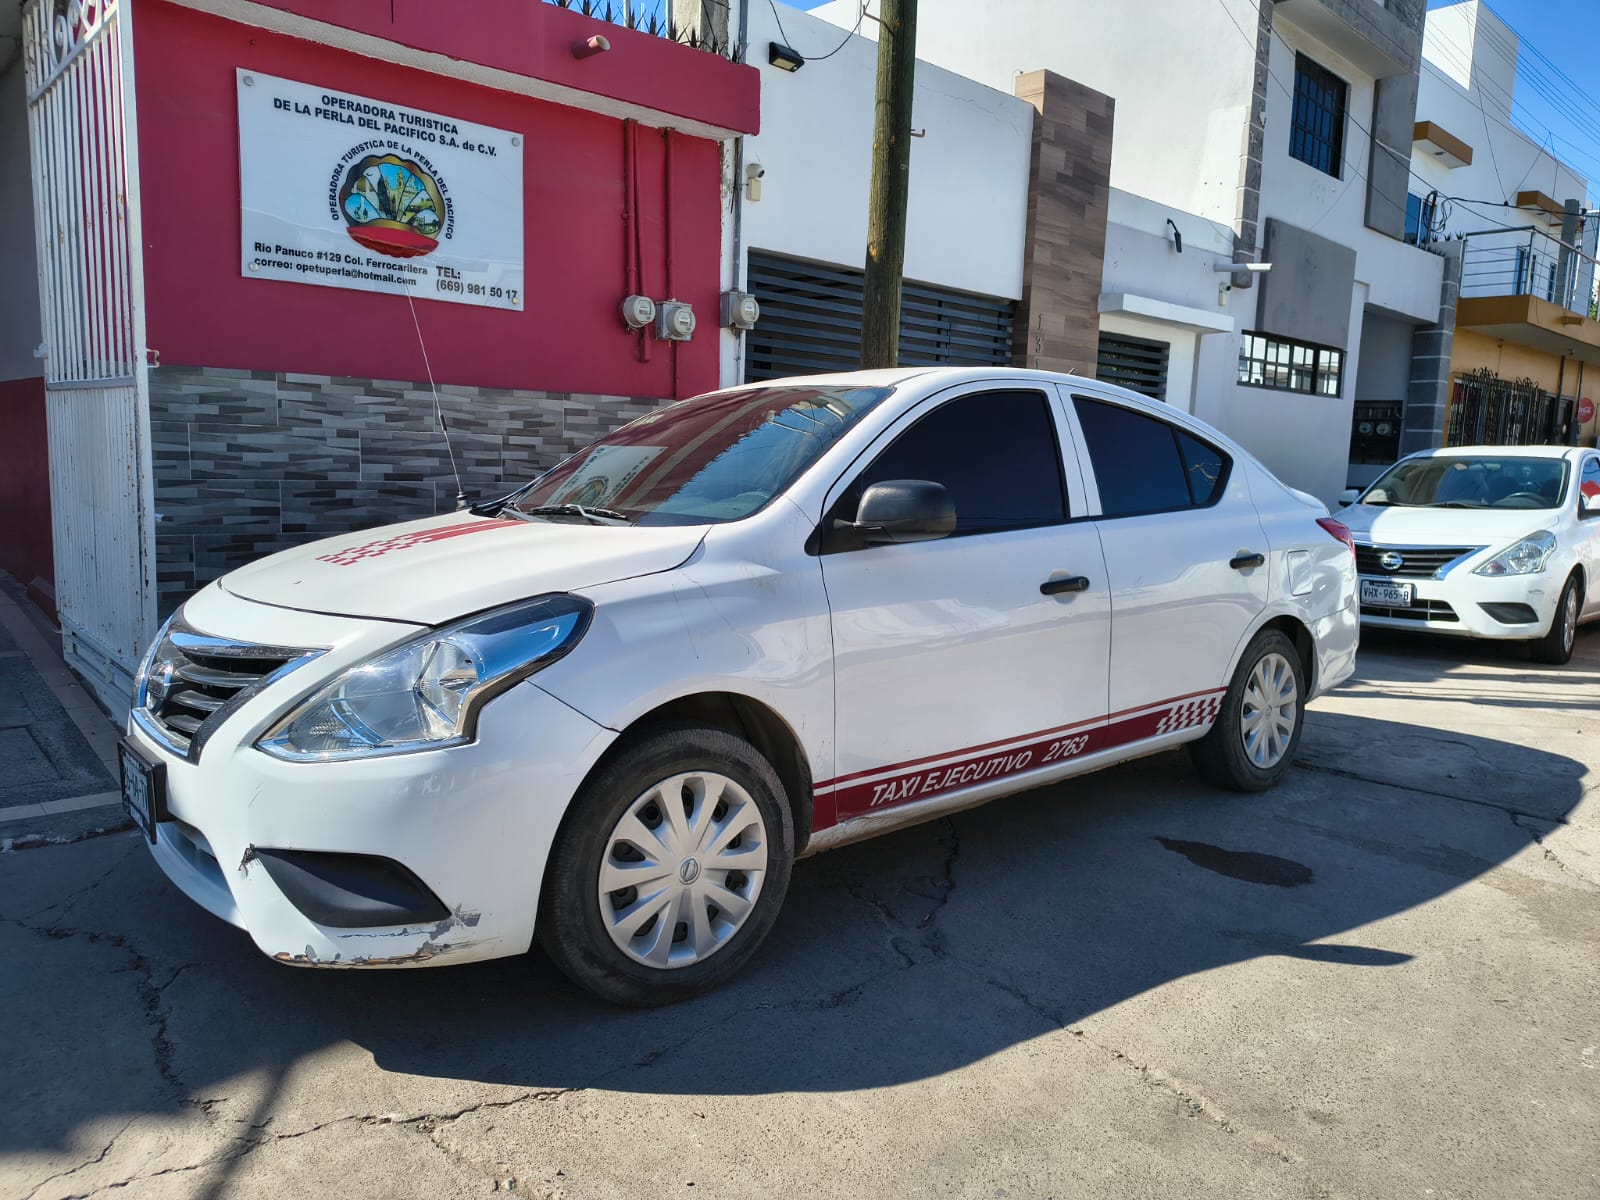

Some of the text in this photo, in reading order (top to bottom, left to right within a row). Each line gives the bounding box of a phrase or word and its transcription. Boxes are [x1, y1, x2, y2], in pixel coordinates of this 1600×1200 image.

[273, 98, 497, 156] DE LA PERLA DEL PACIFICO S.A. de C.V.
[321, 95, 459, 135] OPERADORA TURISTICA
[329, 140, 454, 240] OPERADORA TURISTICA DE LA PERLA DEL PACIFICO
[254, 242, 272, 253] Rio
[275, 245, 313, 259] Panuco
[317, 250, 342, 263] #129
[344, 255, 363, 266] Col.
[254, 258, 293, 270] correo:
[436, 266, 461, 279] TEL:
[436, 279, 518, 299] (669) 981 50 17
[869, 735, 1089, 806] TAXI EJECUTIVO 2763
